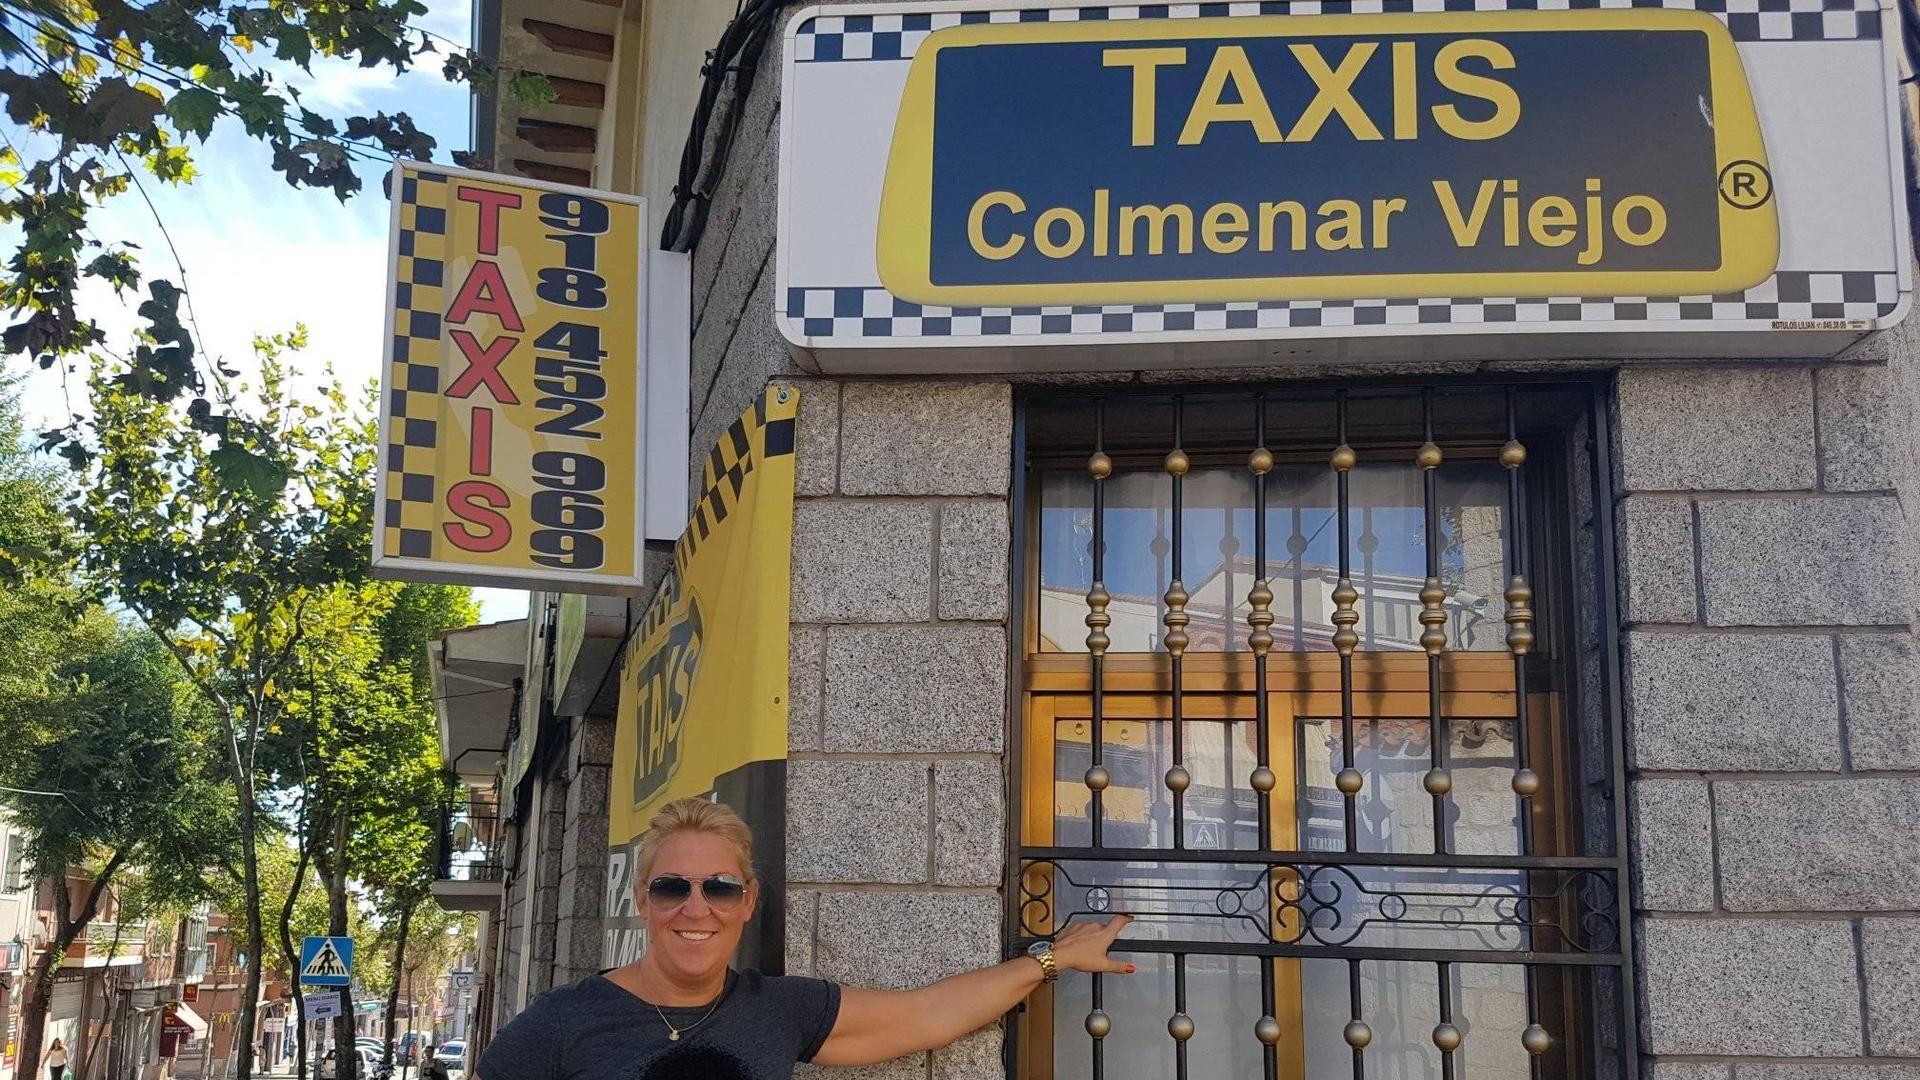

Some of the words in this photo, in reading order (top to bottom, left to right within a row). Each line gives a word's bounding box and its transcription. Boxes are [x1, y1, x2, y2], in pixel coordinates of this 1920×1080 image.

[1102, 39, 1521, 146] TAXIS
[967, 188, 1407, 261] Colmenar
[1432, 178, 1667, 265] Viejo
[442, 185, 525, 553] TAXIS
